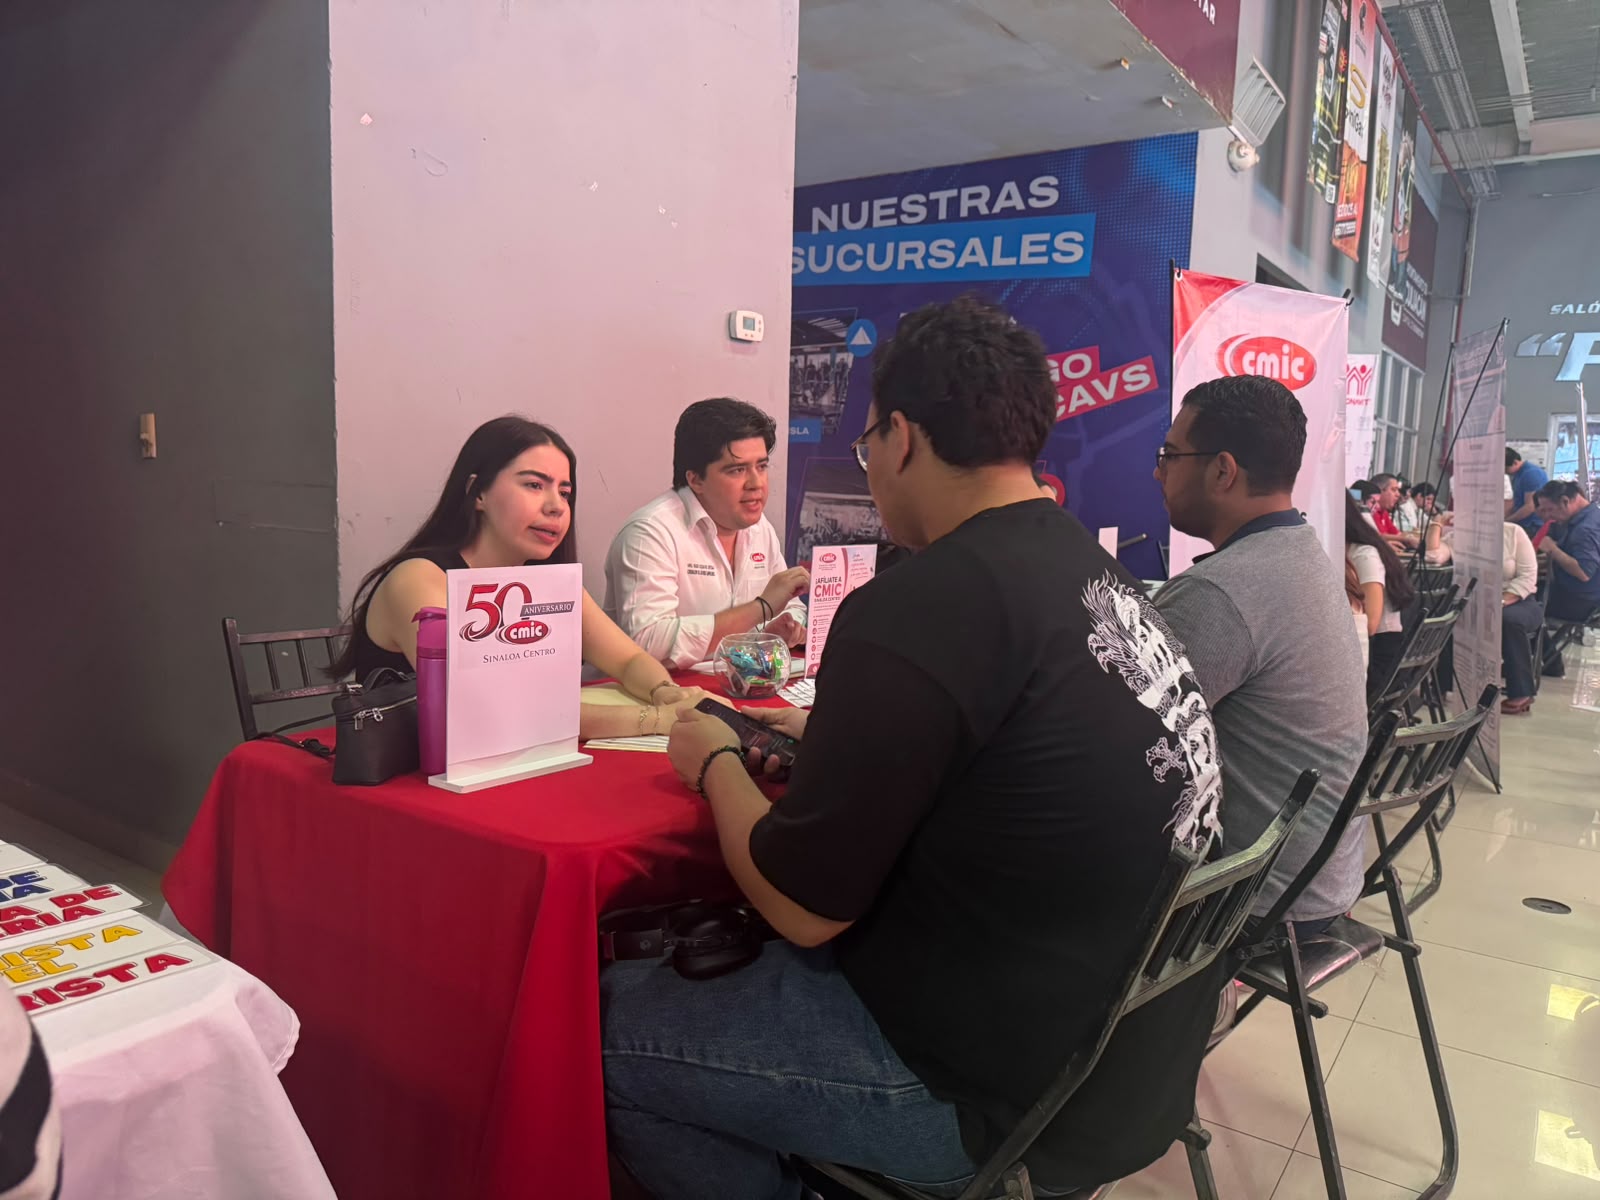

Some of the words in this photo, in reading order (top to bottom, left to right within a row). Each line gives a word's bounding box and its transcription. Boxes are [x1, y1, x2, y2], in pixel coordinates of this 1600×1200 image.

[811, 175, 1060, 235] NUESTRAS
[1241, 343, 1305, 381] cmic
[1056, 364, 1151, 418] AVS
[814, 583, 842, 598] CMIC
[459, 582, 533, 642] 50
[524, 603, 572, 615] ANIVERSARIO
[509, 622, 544, 640] cmic
[483, 652, 521, 664] SINALOA
[523, 648, 556, 659] CENTRO
[49, 885, 122, 909] DE
[0, 904, 106, 938] RIA
[0, 924, 143, 970] ISTA
[0, 958, 78, 984] EL
